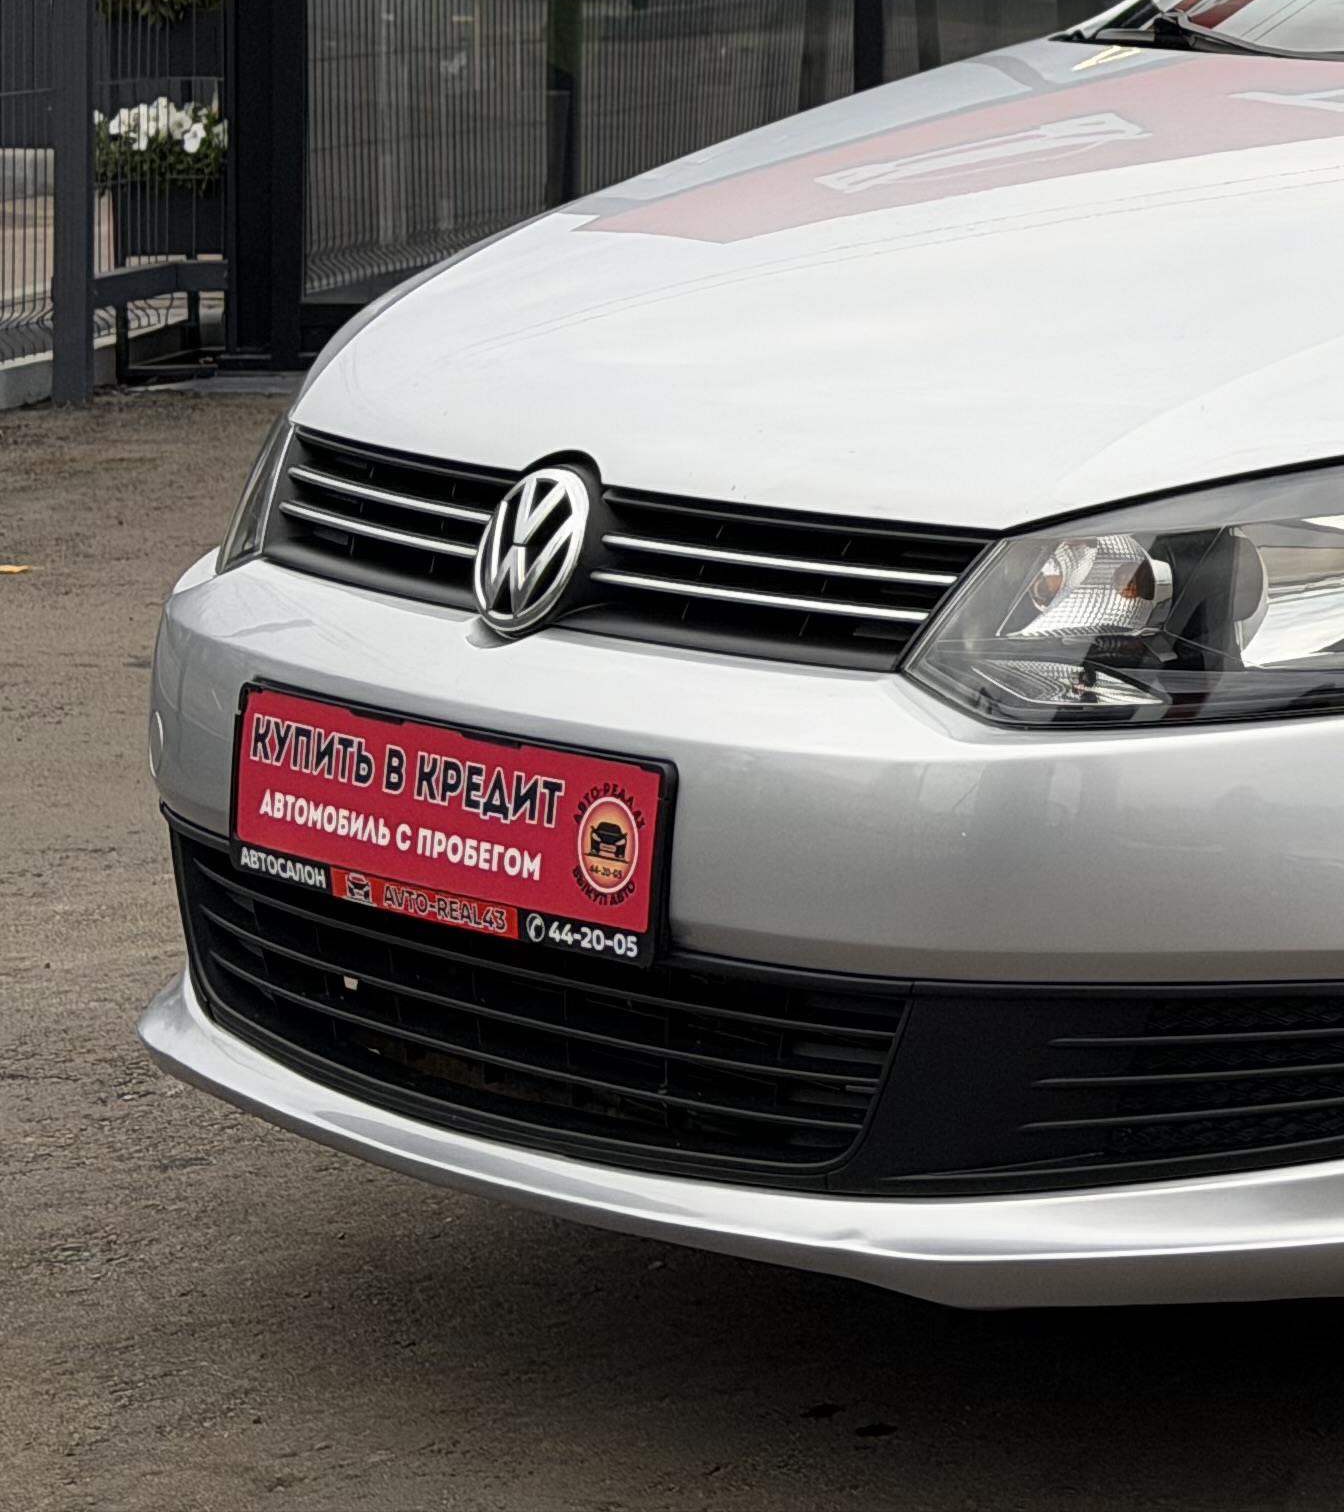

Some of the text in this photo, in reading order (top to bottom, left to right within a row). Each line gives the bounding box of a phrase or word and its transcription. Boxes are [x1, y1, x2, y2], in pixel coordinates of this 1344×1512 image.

[250, 713, 566, 828] КУПИТЬ В КРЕДИТ
[240, 846, 327, 888] АВТОСАЛОН
[259, 789, 542, 881] АВТОМОБИЛЬ С ПРОБЕГОМ
[383, 885, 638, 958] AVTO-REAL43 44-20-05
